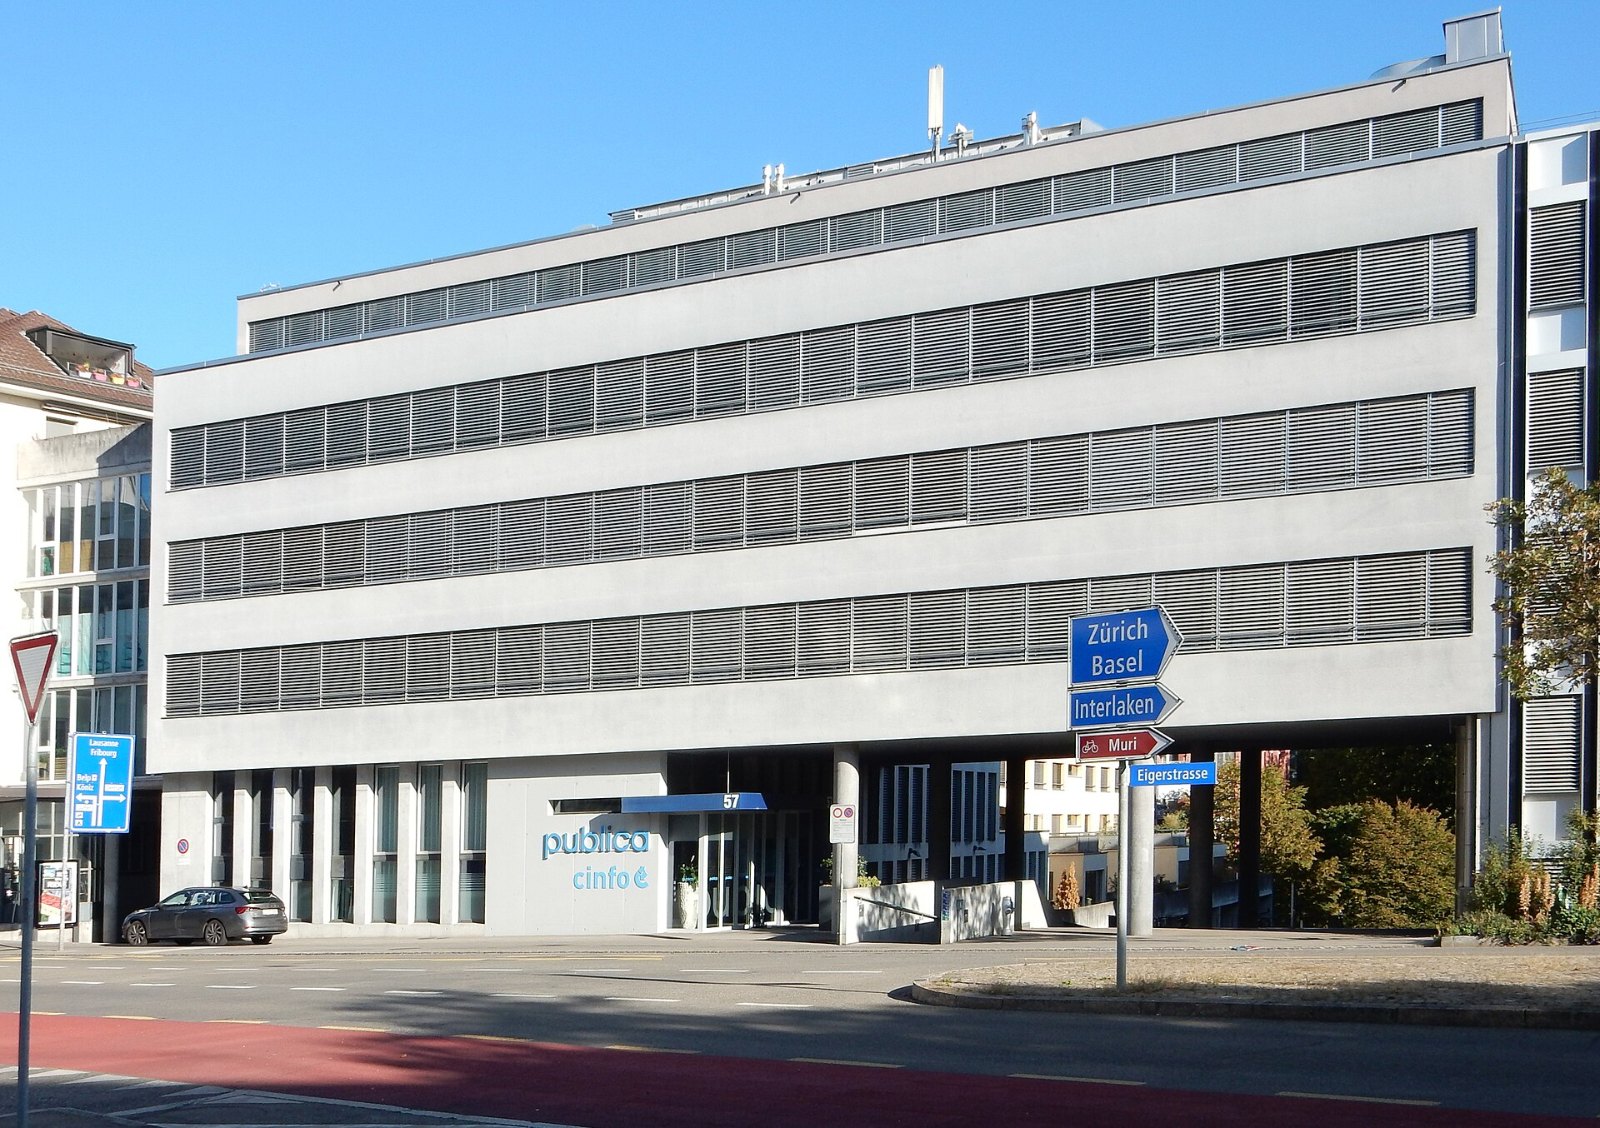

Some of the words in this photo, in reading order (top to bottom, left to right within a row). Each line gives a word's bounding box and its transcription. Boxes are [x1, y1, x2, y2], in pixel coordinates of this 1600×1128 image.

[1087, 617, 1148, 645] Zürich
[1092, 649, 1143, 676] Basel
[1075, 693, 1154, 719] Interlaken
[89, 738, 119, 747] Lausanne
[1108, 737, 1137, 752] Muri
[90, 748, 117, 758] Fribourg
[77, 773, 91, 782] Belp
[1137, 769, 1208, 784] Eigerstrasse
[723, 794, 739, 809] 57
[542, 825, 649, 860] publica
[572, 865, 630, 890] cinfo
